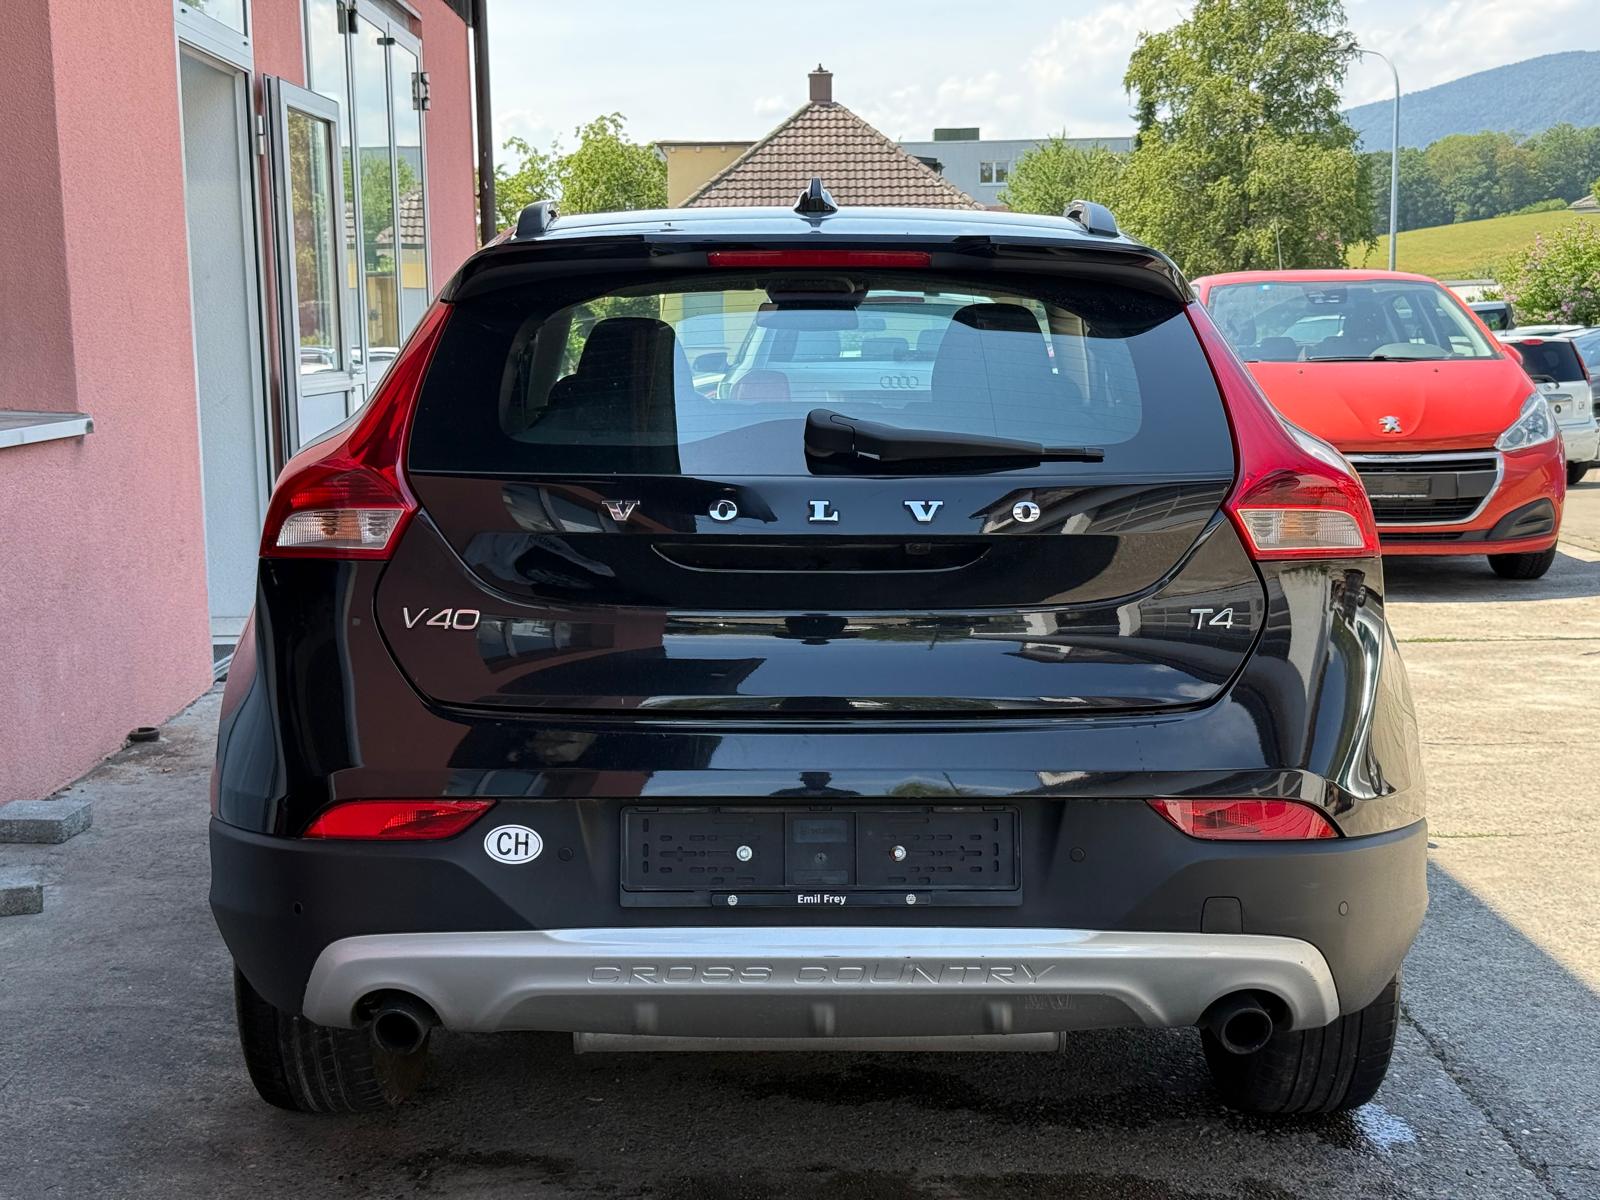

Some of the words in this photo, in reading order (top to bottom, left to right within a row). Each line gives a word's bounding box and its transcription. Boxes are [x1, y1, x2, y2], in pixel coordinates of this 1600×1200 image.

[602, 500, 1040, 522] VOLVO
[403, 607, 481, 630] V40
[1190, 608, 1233, 629] T4
[497, 832, 529, 855] CH
[797, 894, 820, 903] Emil
[823, 894, 847, 905] Frey
[587, 964, 773, 984] CROSS
[794, 964, 1056, 984] COUNTRY
